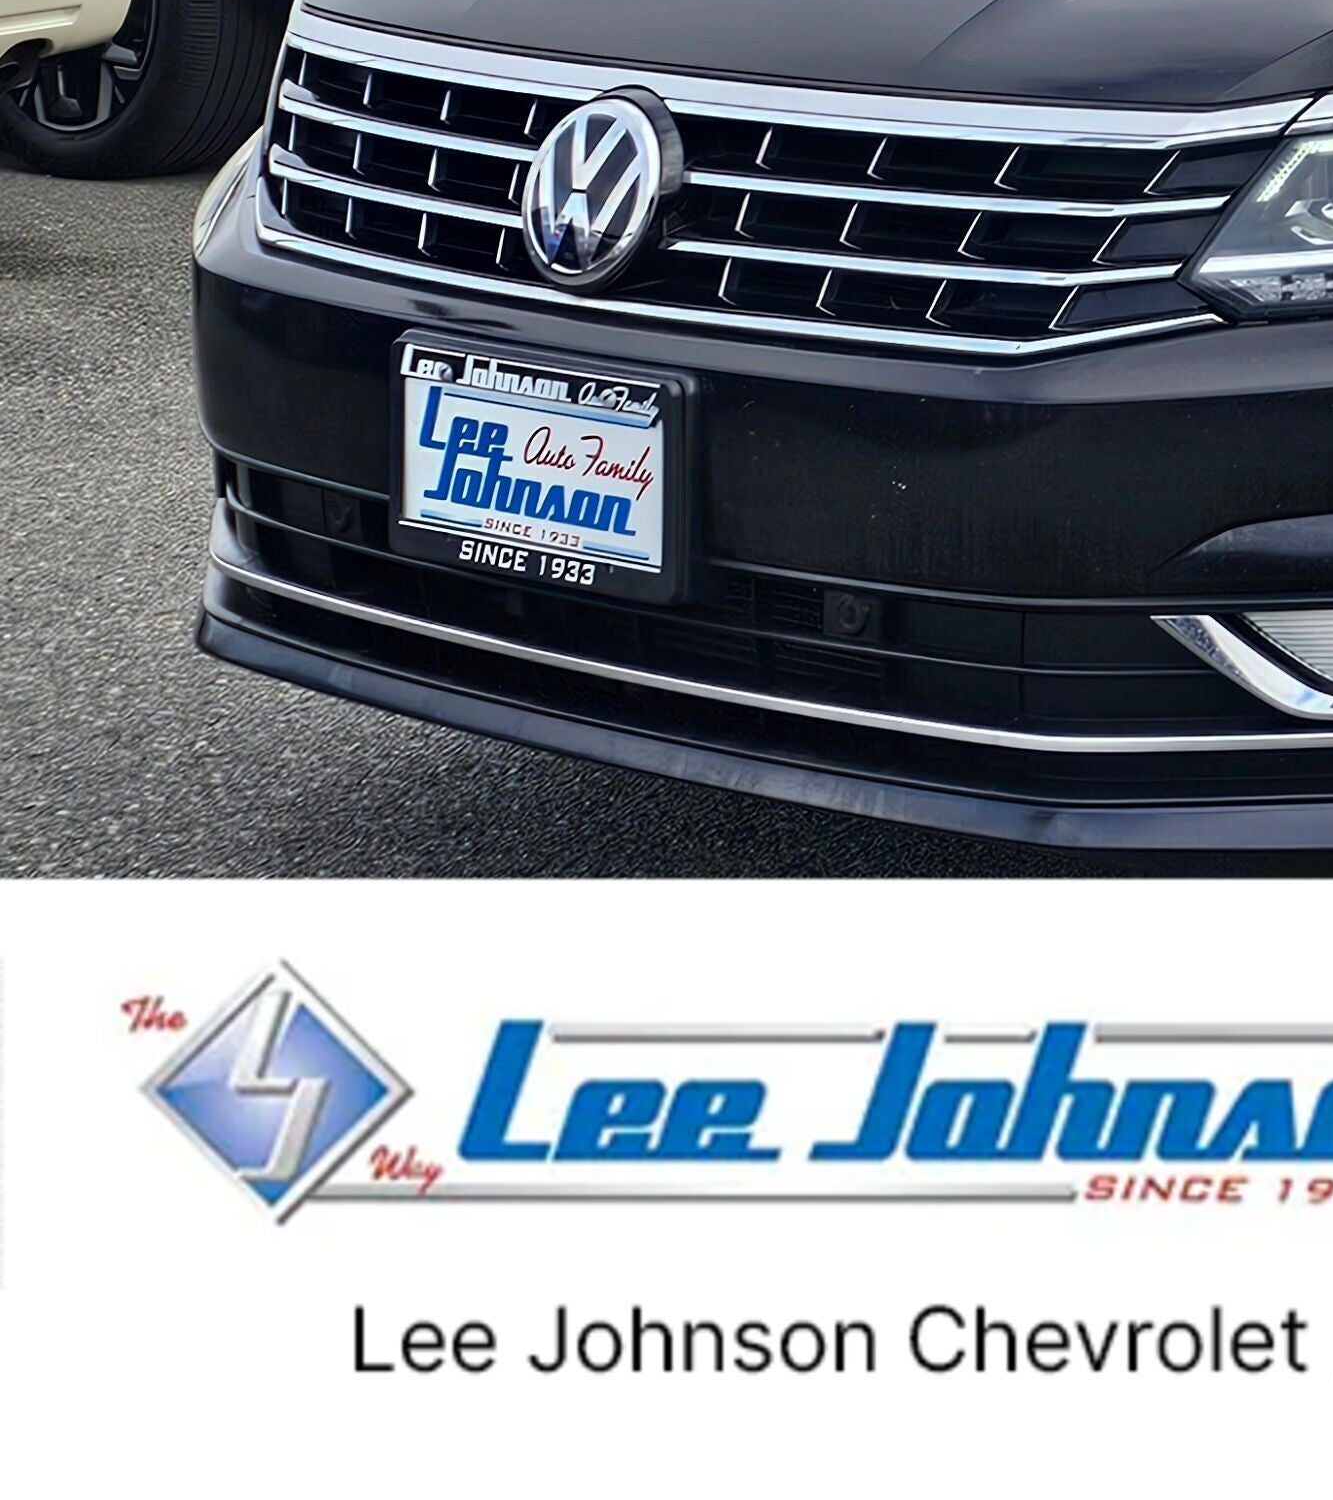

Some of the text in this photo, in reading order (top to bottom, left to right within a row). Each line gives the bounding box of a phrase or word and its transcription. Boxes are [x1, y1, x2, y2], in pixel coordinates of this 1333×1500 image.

[455, 354, 573, 404] Johnson
[418, 385, 656, 502] Lee Auto Family
[422, 442, 638, 537] Johnson
[483, 516, 582, 549] SINCE 1933
[458, 539, 596, 586] SINCE 1933
